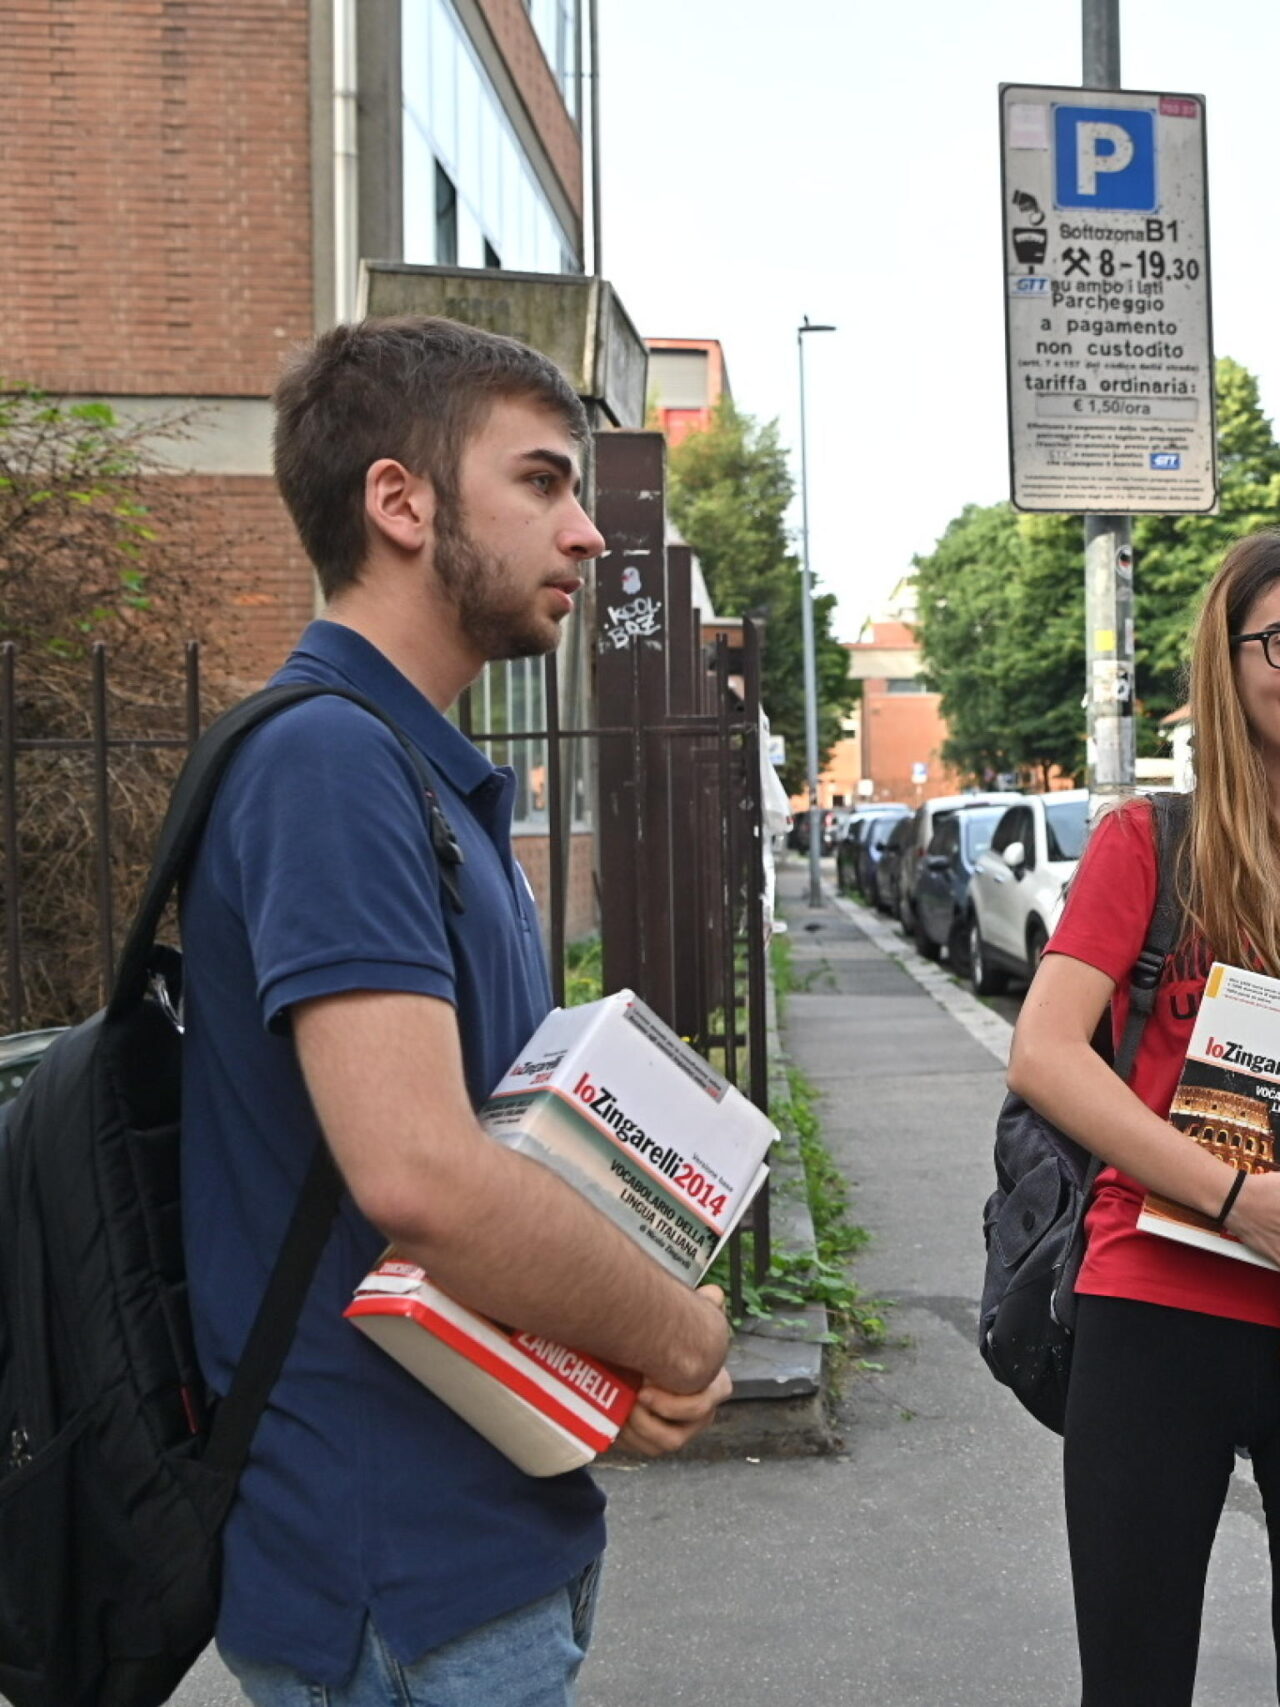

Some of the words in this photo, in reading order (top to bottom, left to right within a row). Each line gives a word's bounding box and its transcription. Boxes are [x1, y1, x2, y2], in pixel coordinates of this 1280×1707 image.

[1076, 120, 1134, 196] P
[1060, 222, 1145, 241] Sottozona
[1146, 218, 1179, 243] B1
[1051, 280, 1071, 293] su
[1075, 280, 1124, 294] ambo
[1137, 280, 1164, 296] lati
[1052, 292, 1165, 314] Parcheggio
[1040, 318, 1052, 331] a
[1067, 318, 1178, 336] pagamento
[1036, 341, 1073, 355] non
[1087, 340, 1184, 358] custodito
[1025, 374, 1087, 392] tariffa
[1099, 376, 1197, 394] ordinaria:
[1073, 399, 1084, 412] €
[609, 1158, 677, 1221] VOCABOLARIO
[674, 1215, 706, 1248] DELLA
[620, 1188, 657, 1225] LINGUA
[655, 1219, 699, 1260] ITALIANA
